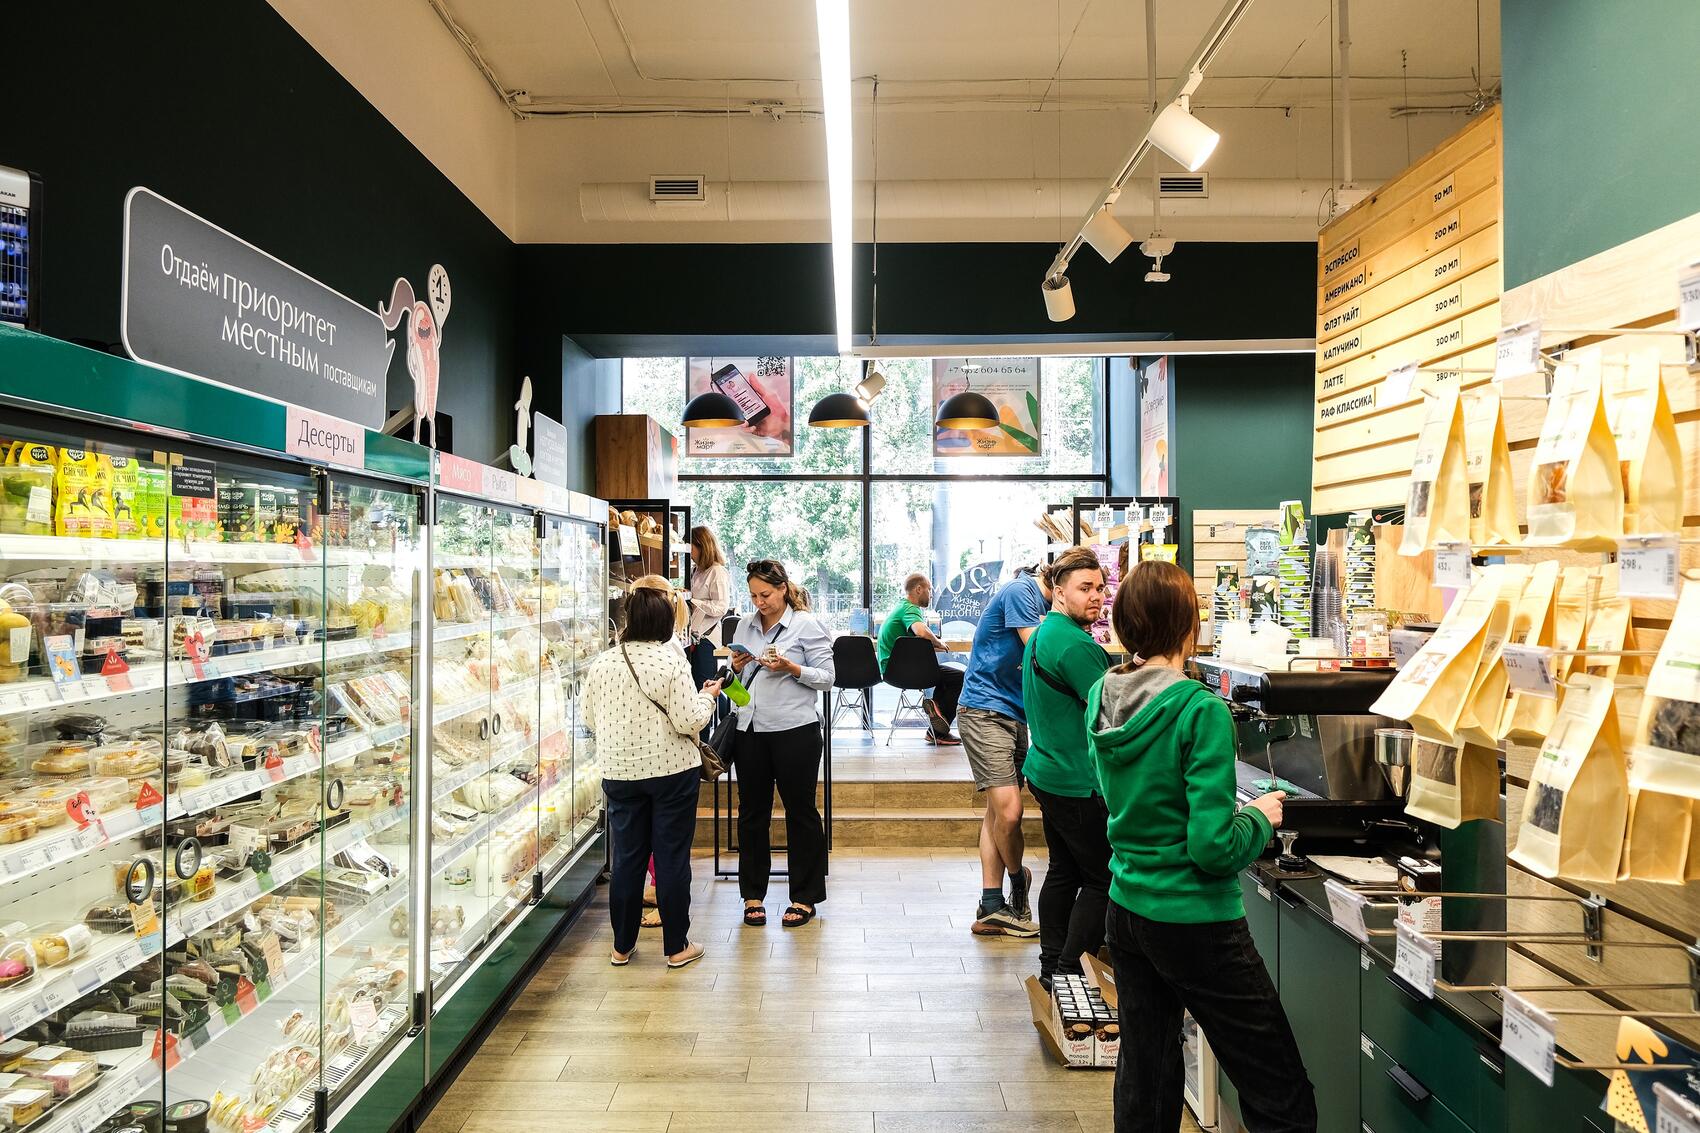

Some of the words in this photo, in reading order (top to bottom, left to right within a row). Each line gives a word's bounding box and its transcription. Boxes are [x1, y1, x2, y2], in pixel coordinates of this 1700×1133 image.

[1434, 190, 1442, 203] 30
[1443, 185, 1453, 199] МЛ
[1434, 227, 1447, 240] 200
[1448, 222, 1458, 235] МЛ
[1324, 247, 1358, 275] ЭСПРЕССО
[1434, 264, 1447, 277] 200
[1448, 258, 1459, 272] МЛ
[161, 244, 219, 297] Отдаём
[223, 273, 337, 347] приоритет
[1324, 273, 1364, 303] АМЕРИКАНО
[1435, 299, 1448, 312] 300
[1449, 294, 1459, 307] МЛ
[1323, 315, 1342, 332] ФЛЭТ
[1342, 306, 1360, 327] УАЙТ
[1436, 335, 1449, 347] 300
[1449, 330, 1460, 343] МЛ
[221, 316, 320, 376] местным
[323, 363, 378, 399] поставщикам
[1323, 337, 1360, 361] КАПУЧИНО
[980, 366, 998, 374] 604
[1001, 366, 1012, 374] 65
[1014, 366, 1027, 374] 64
[1436, 371, 1448, 383] 380
[1323, 373, 1344, 390] ЛАТТЕ
[1320, 405, 1336, 419] РАФ
[1336, 394, 1373, 416] КЛАССИКА
[298, 419, 356, 455] Десерты
[452, 463, 472, 489] Мясо
[491, 473, 507, 492] Рыба
[1620, 558, 1637, 570] 298
[951, 594, 981, 607] Жизнь
[1505, 1018, 1519, 1034] 140
